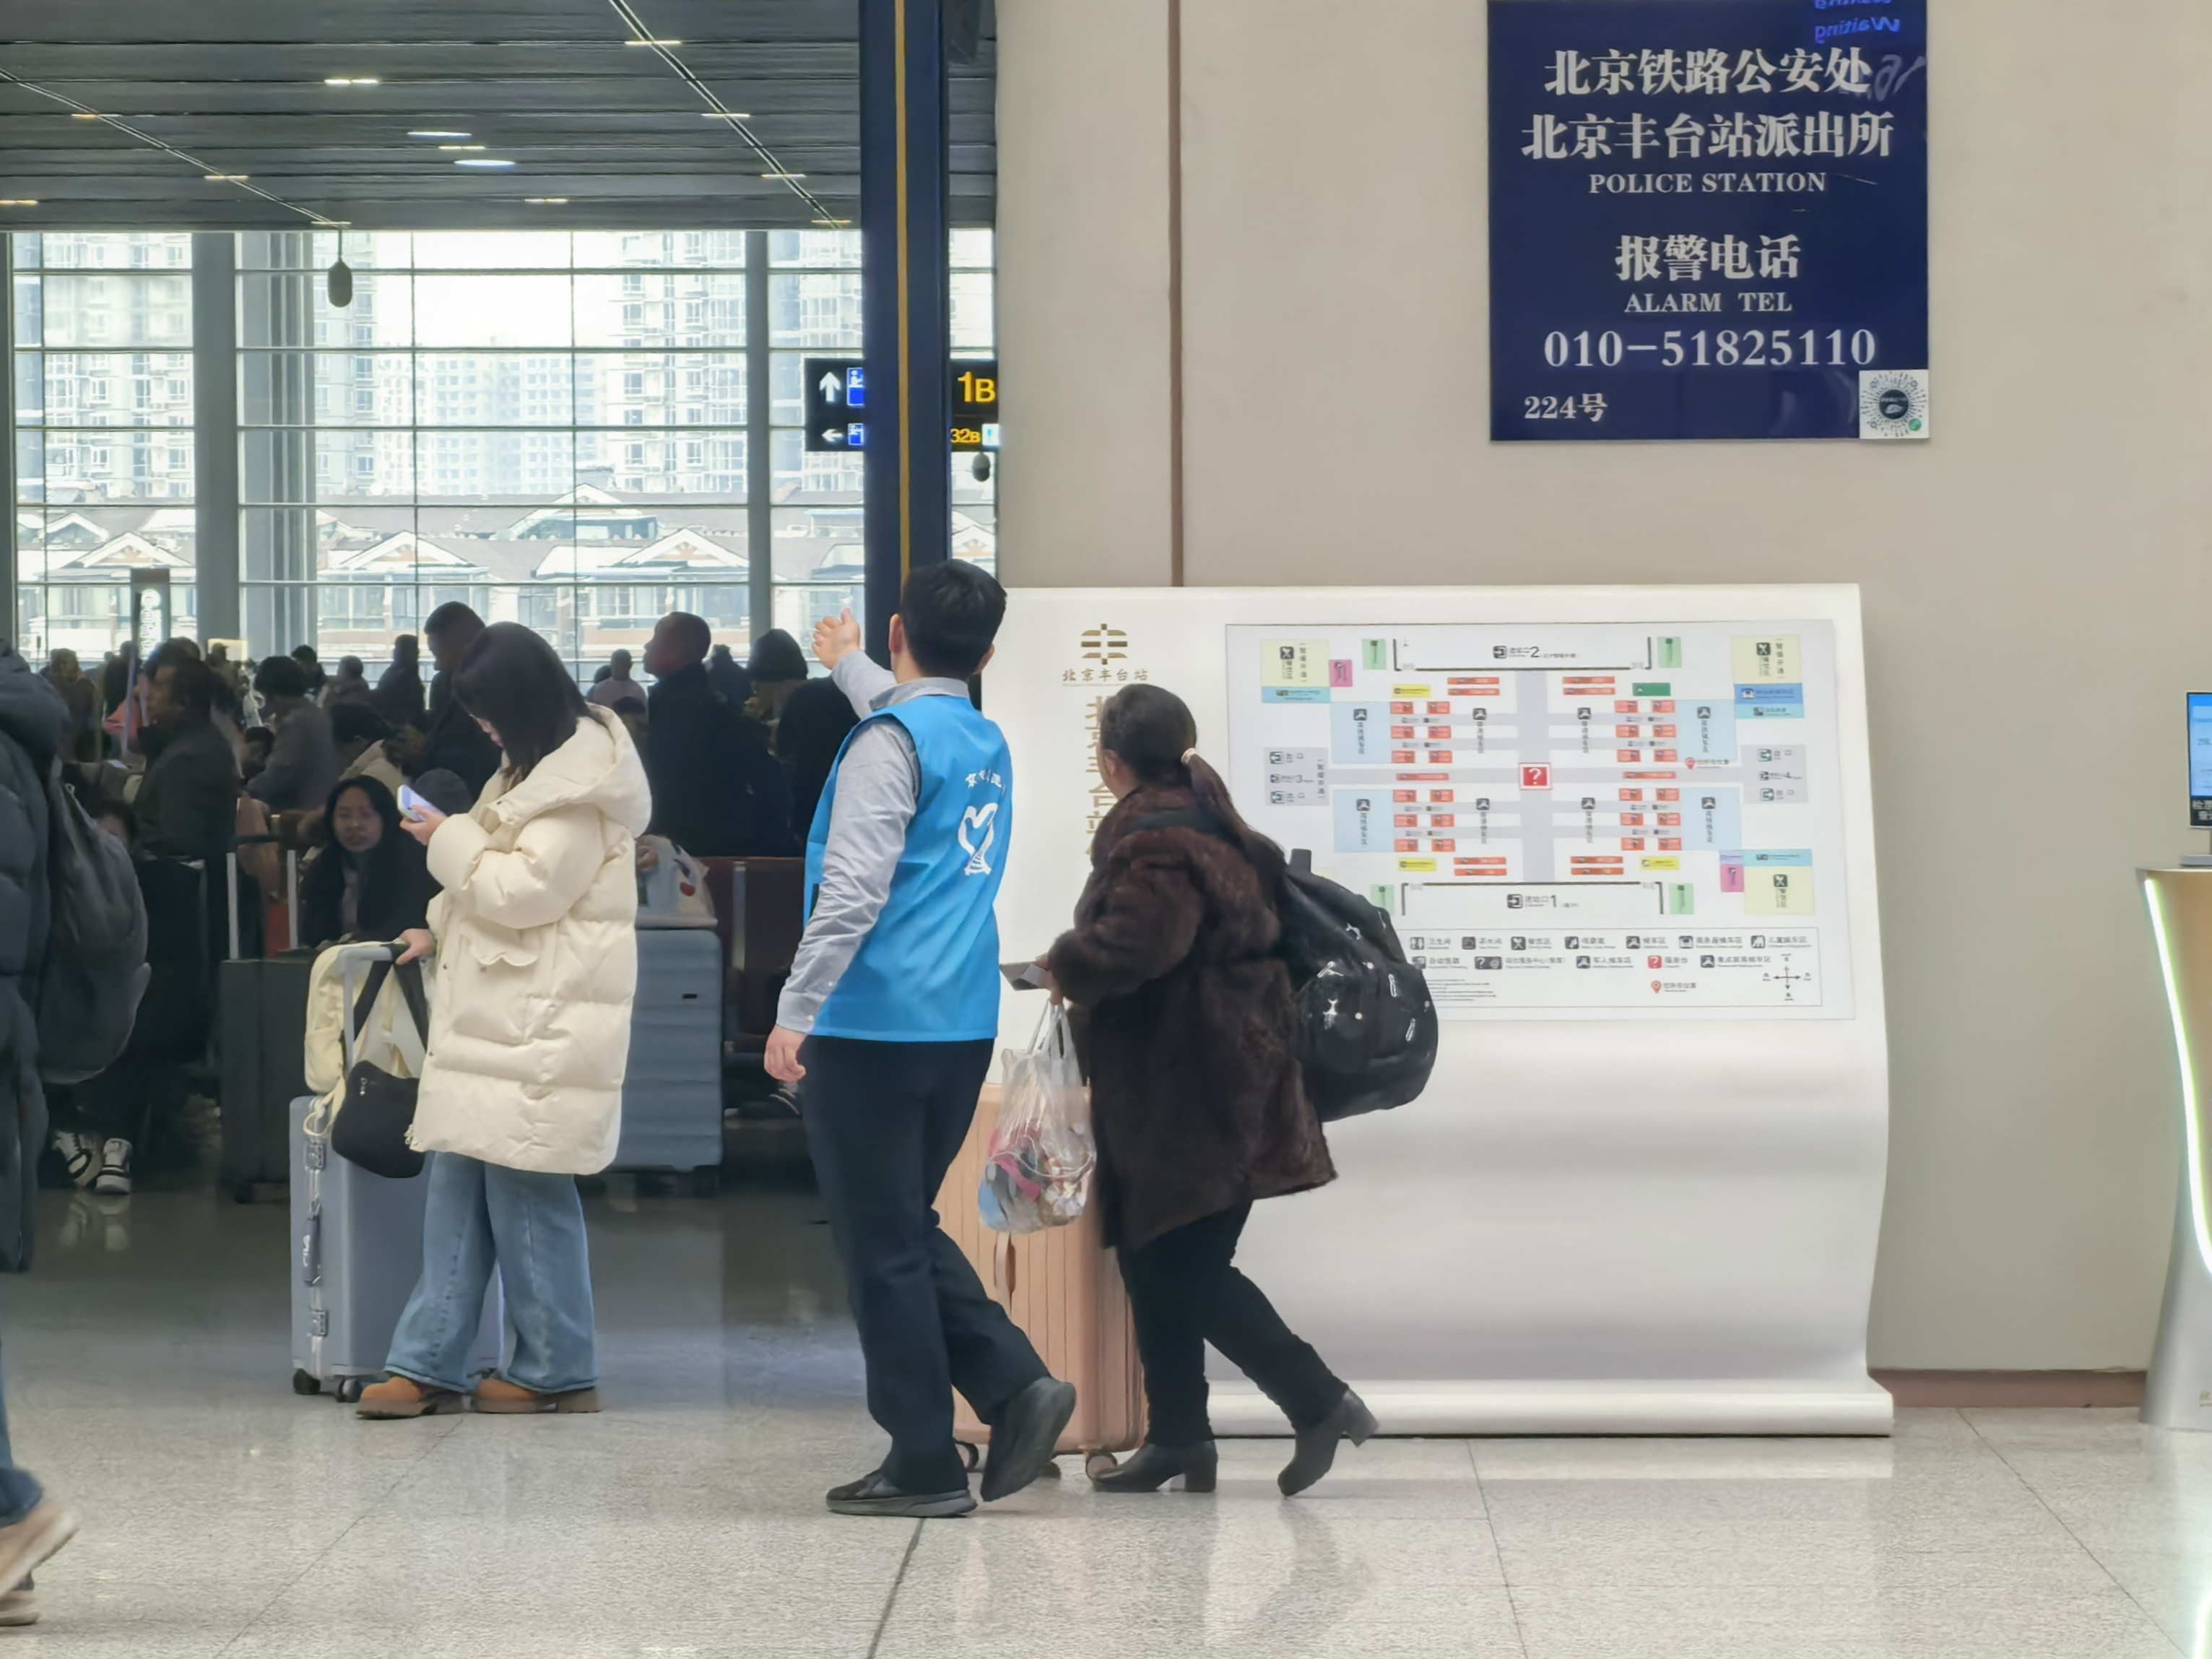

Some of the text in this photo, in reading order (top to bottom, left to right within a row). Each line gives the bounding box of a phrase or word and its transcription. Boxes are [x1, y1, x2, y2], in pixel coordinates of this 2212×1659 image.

[1544, 48, 1872, 95] 北京铁路公安处
[1521, 111, 1894, 159] 北京丰台站派出所
[1589, 172, 1826, 193] POLICE STATION
[1615, 234, 1801, 281] 报警电话
[1624, 292, 1792, 312] ALARM TEL
[958, 371, 996, 402] 1B
[1524, 392, 1608, 423] 224号
[1062, 668, 1148, 682] 北京丰台站
